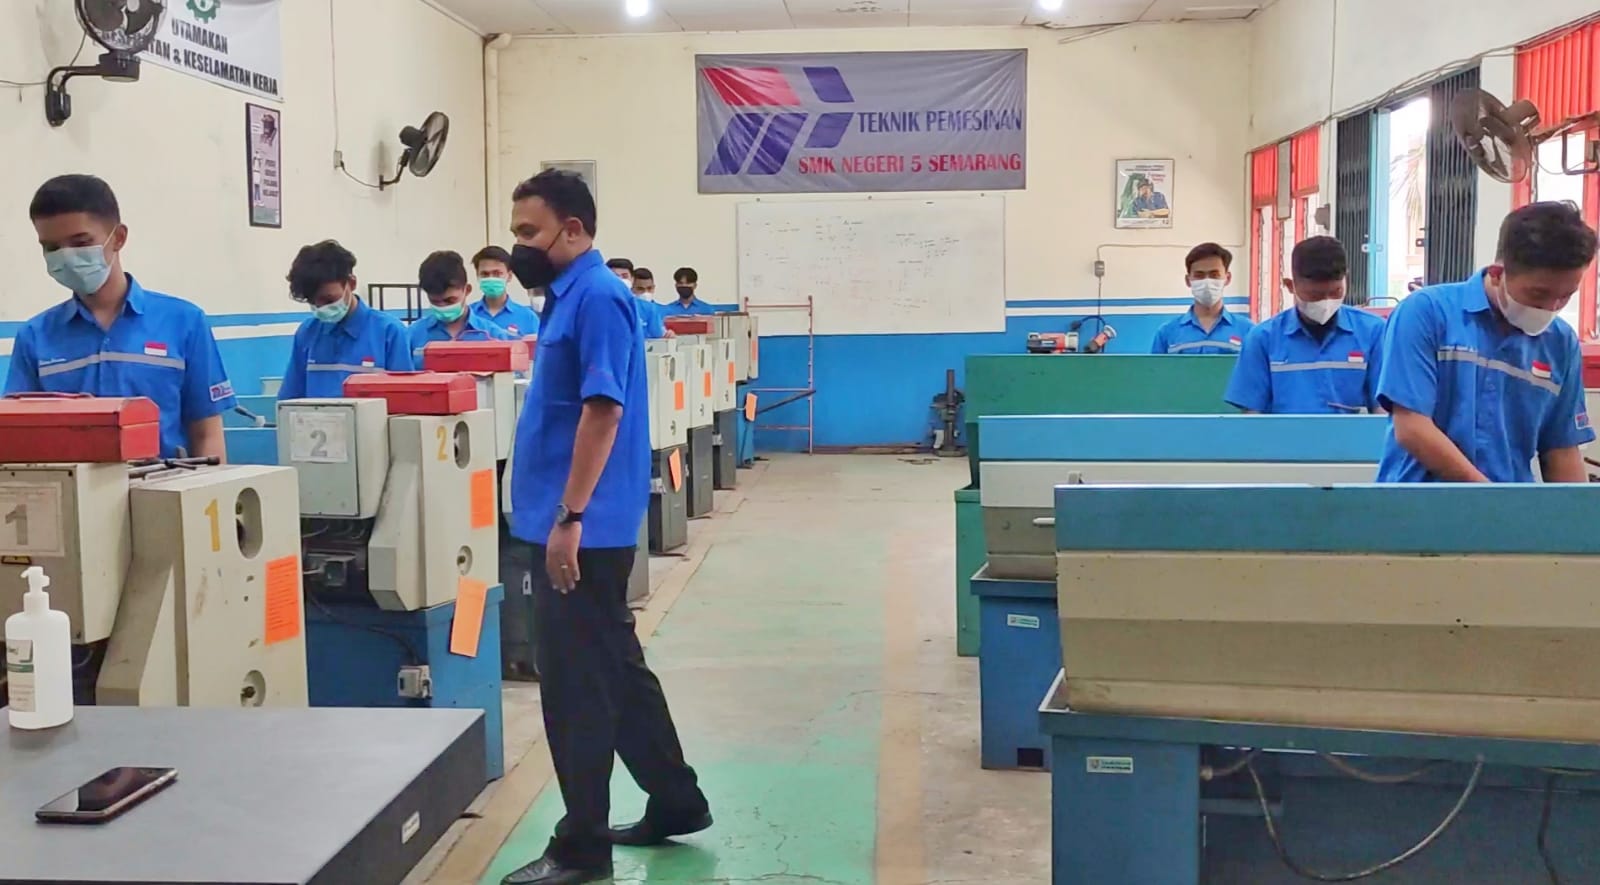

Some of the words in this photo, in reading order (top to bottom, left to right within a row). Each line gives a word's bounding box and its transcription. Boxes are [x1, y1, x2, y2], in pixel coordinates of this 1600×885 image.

[171, 17, 229, 55] UTAMAKAN
[173, 48, 182, 65] &
[183, 48, 251, 88] KESELAMATAN
[252, 71, 278, 96] KERJA
[858, 111, 920, 133] TEKNIK
[926, 109, 1022, 132] PEMESINAN
[799, 156, 836, 174] SMK
[842, 155, 904, 174] NEGERI
[911, 154, 922, 173] 5
[928, 153, 1022, 173] SEMARANG
[310, 429, 328, 457] 2
[436, 424, 448, 461] 2
[5, 503, 28, 546] 1
[205, 498, 221, 552] 1
